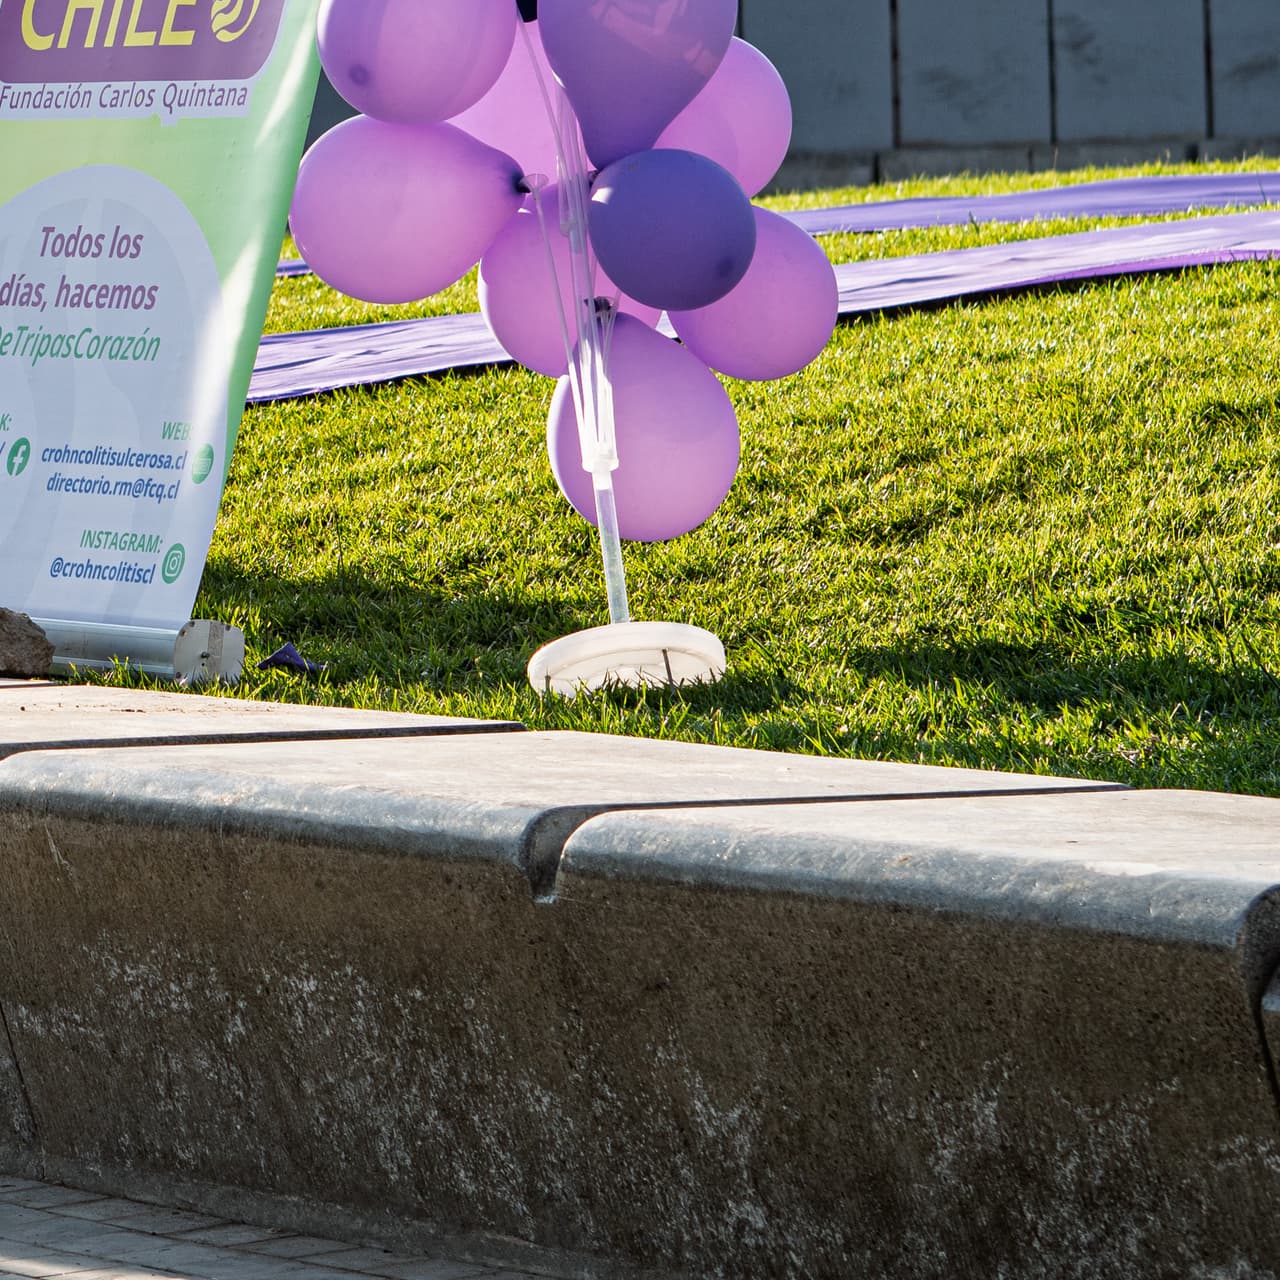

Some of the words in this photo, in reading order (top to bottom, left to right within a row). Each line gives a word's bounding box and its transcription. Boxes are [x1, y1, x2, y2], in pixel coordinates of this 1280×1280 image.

[98, 83, 155, 109] Carlos
[162, 81, 248, 115] Quintana
[40, 225, 104, 259] Todos
[108, 225, 144, 259] los
[54, 275, 159, 310] hacemos
[41, 444, 188, 471] crohncolitisulcerosa.cl
[46, 473, 180, 504] directorio.rm@fcq.cl
[79, 529, 164, 554] INSTAGRAM:
[49, 556, 156, 585] @crohncolitiscl
